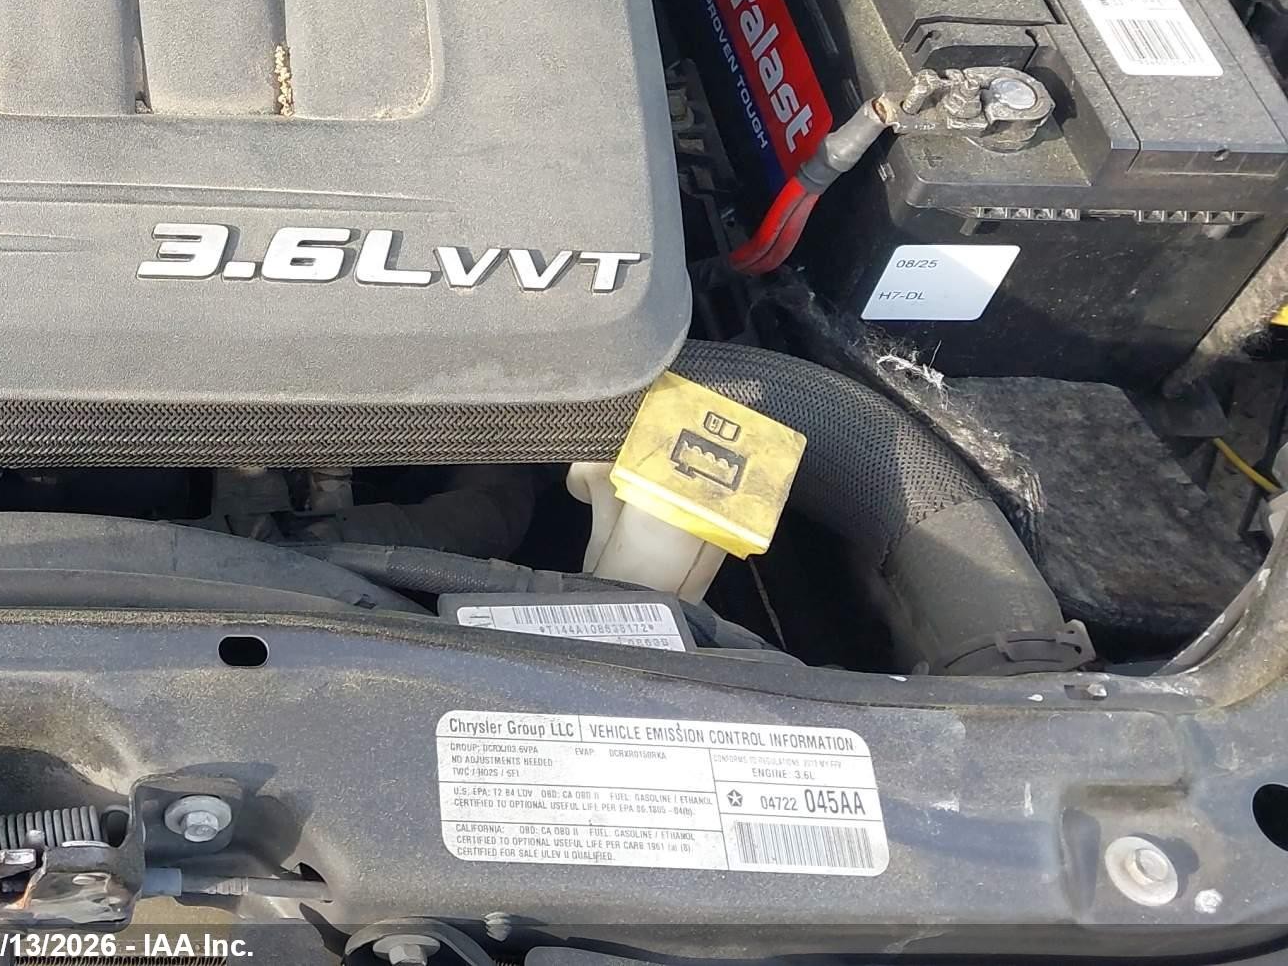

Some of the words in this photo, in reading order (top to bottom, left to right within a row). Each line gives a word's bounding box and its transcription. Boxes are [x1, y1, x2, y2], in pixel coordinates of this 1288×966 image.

[736, 78, 769, 150] TOUGH
[896, 259, 938, 269] 08/25
[878, 291, 926, 300] H7-DL
[449, 718, 502, 736] Chrysler
[507, 720, 545, 738] Group
[550, 722, 575, 737] LLC
[589, 723, 641, 740] VEHICLE
[645, 726, 705, 743] EMISSION
[709, 730, 766, 747] CONTROL
[770, 732, 854, 751] INFORMATION
[451, 755, 462, 764] NO
[465, 756, 521, 766] ADJUSTMENTS
[524, 758, 553, 767] NEEDED
[454, 798, 494, 808] CERTIFIED
[497, 799, 507, 808] TO
[509, 800, 548, 810] OPTIONAL
[550, 801, 580, 811] USEFUL
[601, 804, 616, 812] PER
[634, 794, 672, 803] GASOLINE
[760, 795, 799, 811] 04722
[804, 788, 866, 815] 045AA
[541, 826, 552, 835] CA
[614, 829, 652, 839] GASOLINE
[456, 835, 496, 845] CERTIFIED
[499, 837, 510, 845] TO
[512, 837, 551, 847] OPTIONAL
[553, 838, 583, 848] USEFUL
[586, 839, 602, 848] LIFE
[606, 840, 621, 849] PER
[623, 841, 644, 850] CARB
[457, 847, 496, 857] CERTIFIED
[499, 848, 516, 857] FOR
[518, 849, 539, 858] SALE
[541, 849, 561, 859] ULEV
